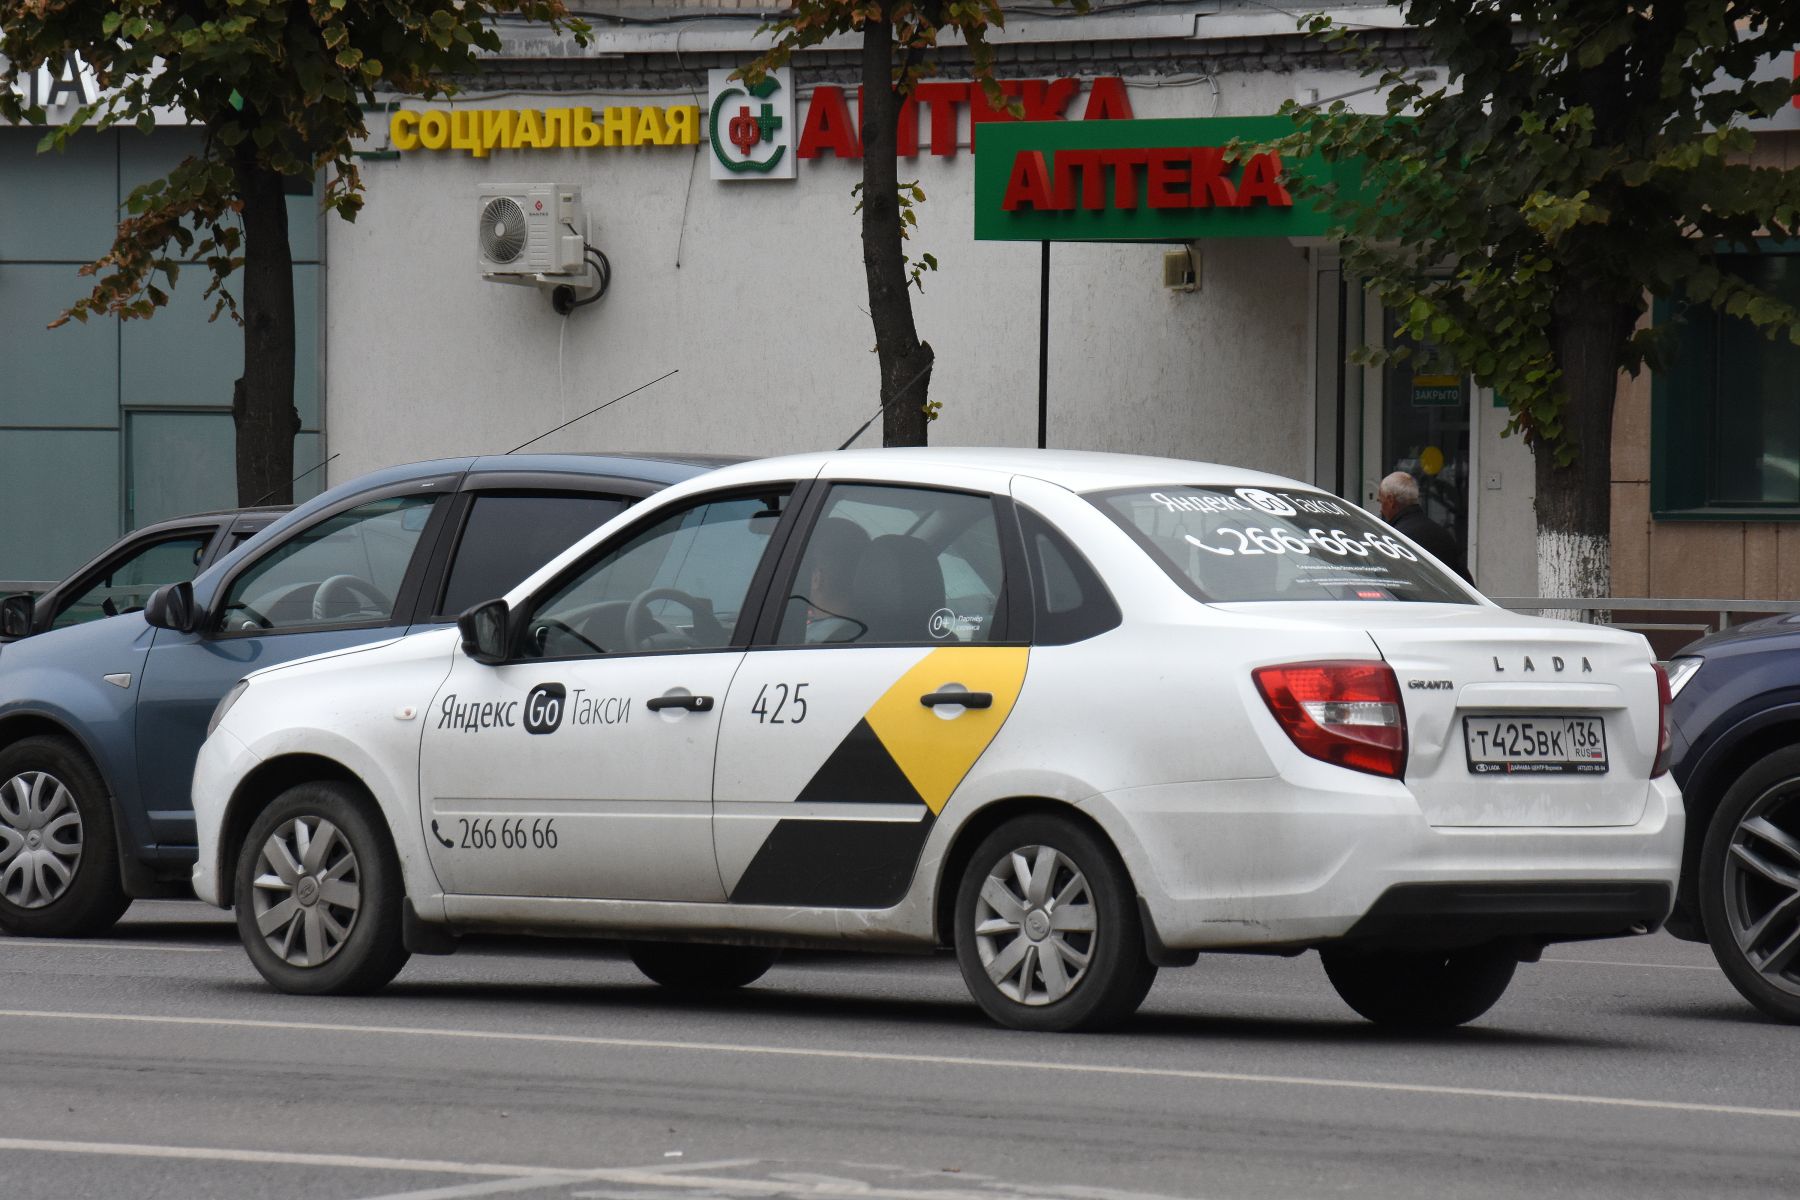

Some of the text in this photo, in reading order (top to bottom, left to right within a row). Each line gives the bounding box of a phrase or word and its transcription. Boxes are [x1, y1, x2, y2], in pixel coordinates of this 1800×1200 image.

[389, 105, 699, 157] СОЦИАЛЬНАЯ
[1001, 146, 1293, 210] АПТЕКА
[1415, 390, 1458, 400] ЗАКРЫТО
[1150, 492, 1351, 516] Яндекс Go Такси
[1218, 527, 1418, 562] 266-66-66
[1493, 656, 1593, 673] LADA
[1408, 680, 1453, 690] GRANTA
[437, 689, 631, 733] Яндекс Go Такси
[751, 683, 809, 724] 425
[1566, 721, 1597, 748] 136
[1576, 748, 1591, 758] RUS
[459, 818, 558, 849] 266 66 66
